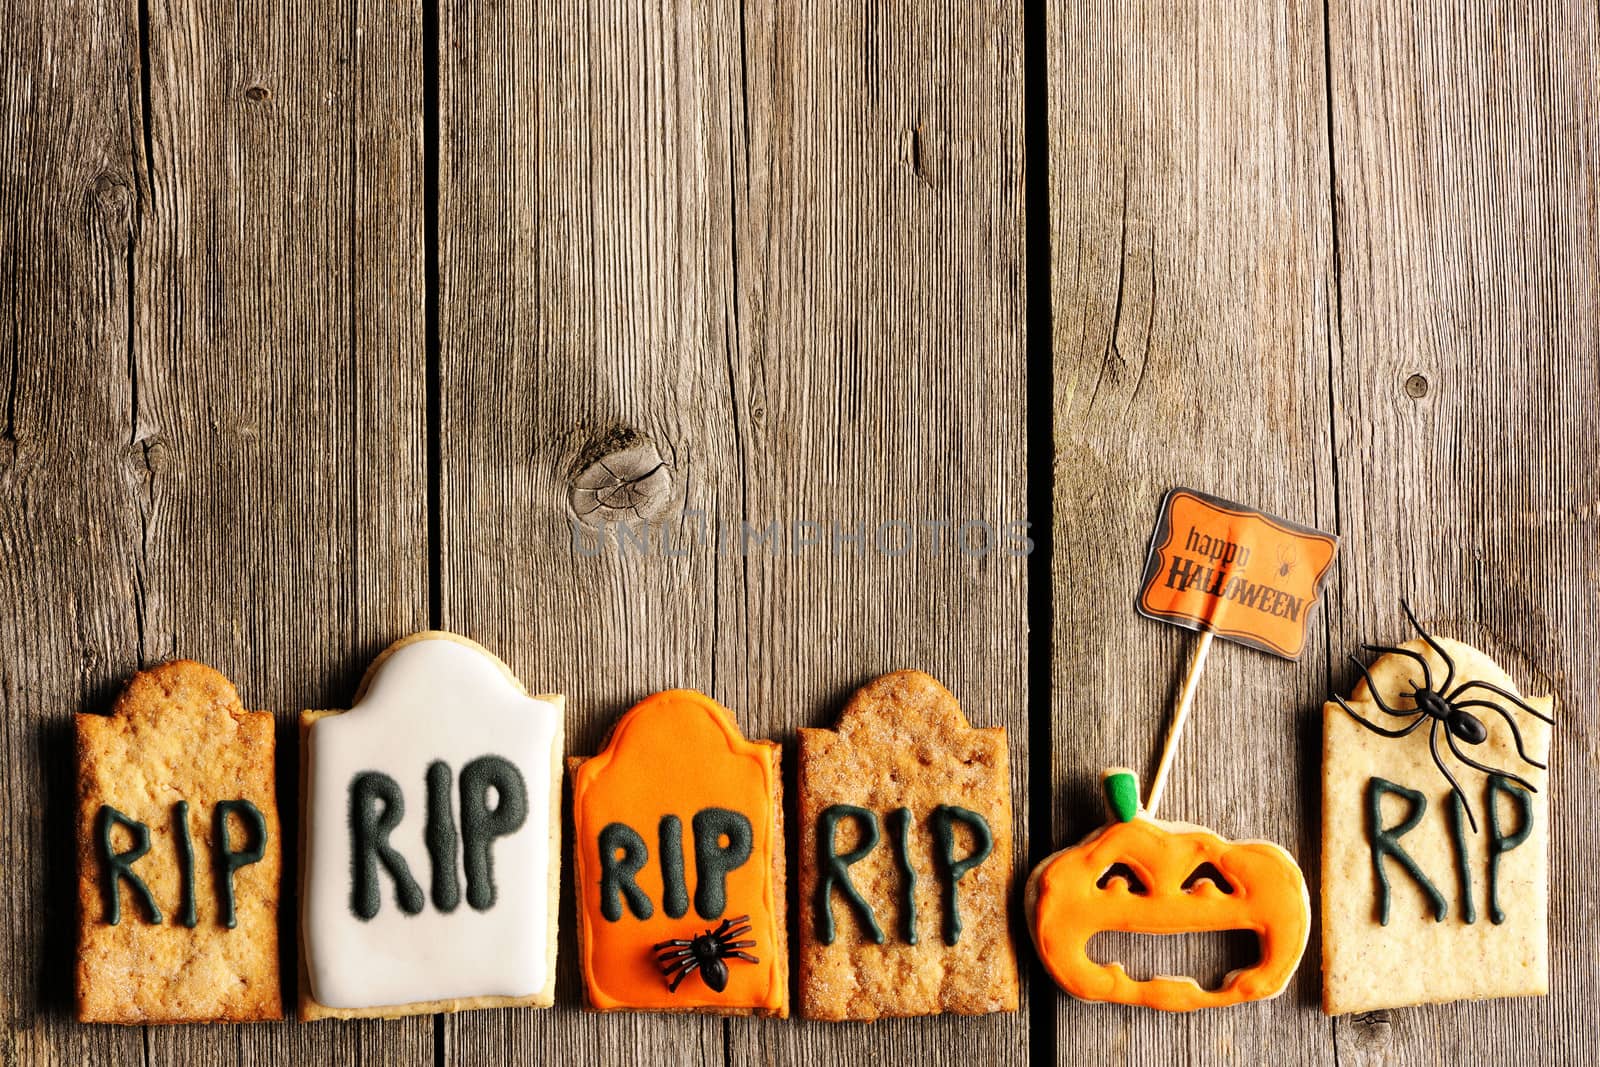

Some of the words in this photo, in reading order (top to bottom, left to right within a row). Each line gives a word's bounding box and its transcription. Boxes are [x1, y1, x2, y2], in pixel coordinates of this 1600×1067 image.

[1164, 555, 1305, 622] HALLOWEEN
[1184, 525, 1251, 573] happy
[97, 799, 268, 929] RIP
[347, 754, 529, 922] RIP
[599, 806, 754, 922] RIP
[817, 803, 994, 946] RIP
[1368, 774, 1534, 927] RIP
